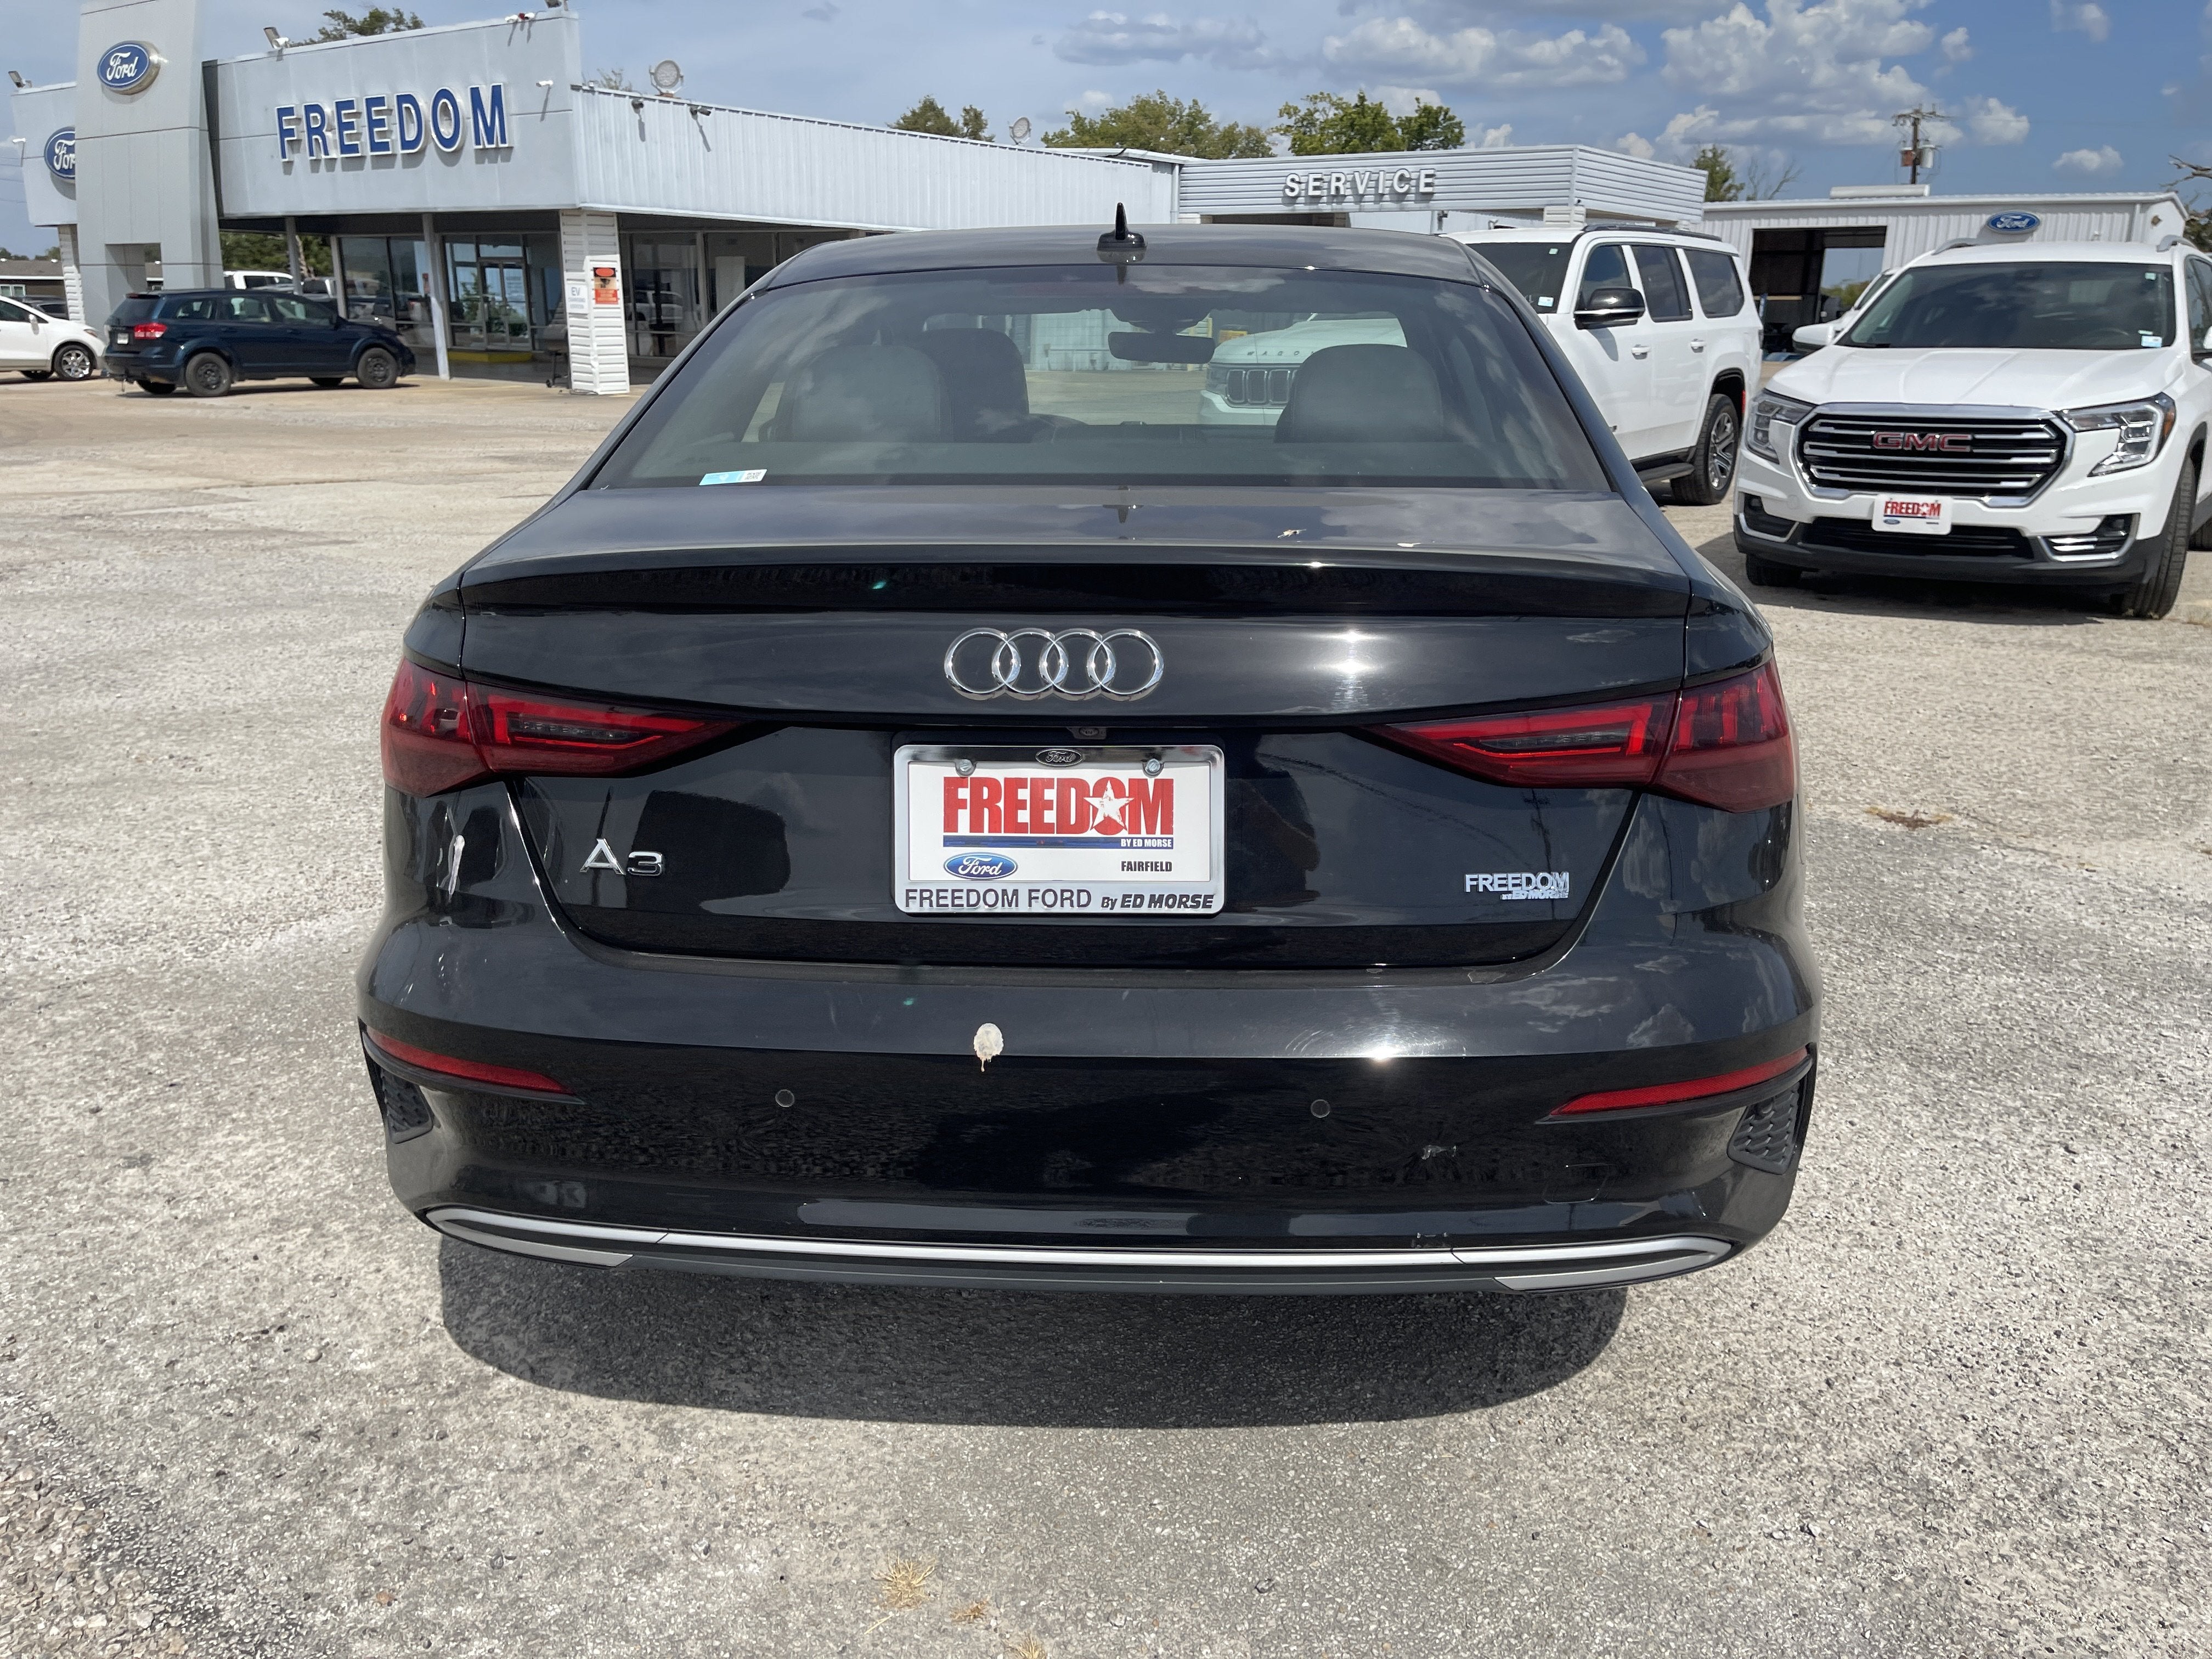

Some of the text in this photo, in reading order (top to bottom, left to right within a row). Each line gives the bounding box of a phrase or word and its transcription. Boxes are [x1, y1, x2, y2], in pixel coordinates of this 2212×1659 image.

[106, 52, 138, 80] Ford
[276, 83, 509, 162] FREEDOM
[54, 139, 75, 170] For
[1284, 168, 1436, 196] SERVICE
[571, 287, 580, 296] EV
[1873, 431, 1973, 453] GMC
[1884, 501, 1942, 517] FREEDOM
[1045, 751, 1077, 763] Ford
[943, 776, 1174, 836] FREEDOM
[1121, 838, 1172, 848] BY ED MORSE
[580, 838, 664, 876] A3
[958, 856, 1004, 875] Ford
[1121, 861, 1172, 872] FAIRFIELD
[1464, 871, 1570, 893] FREEDOM
[905, 889, 1214, 910] FREEDOM FORD By ED MORSE
[1512, 890, 1527, 900] ED
